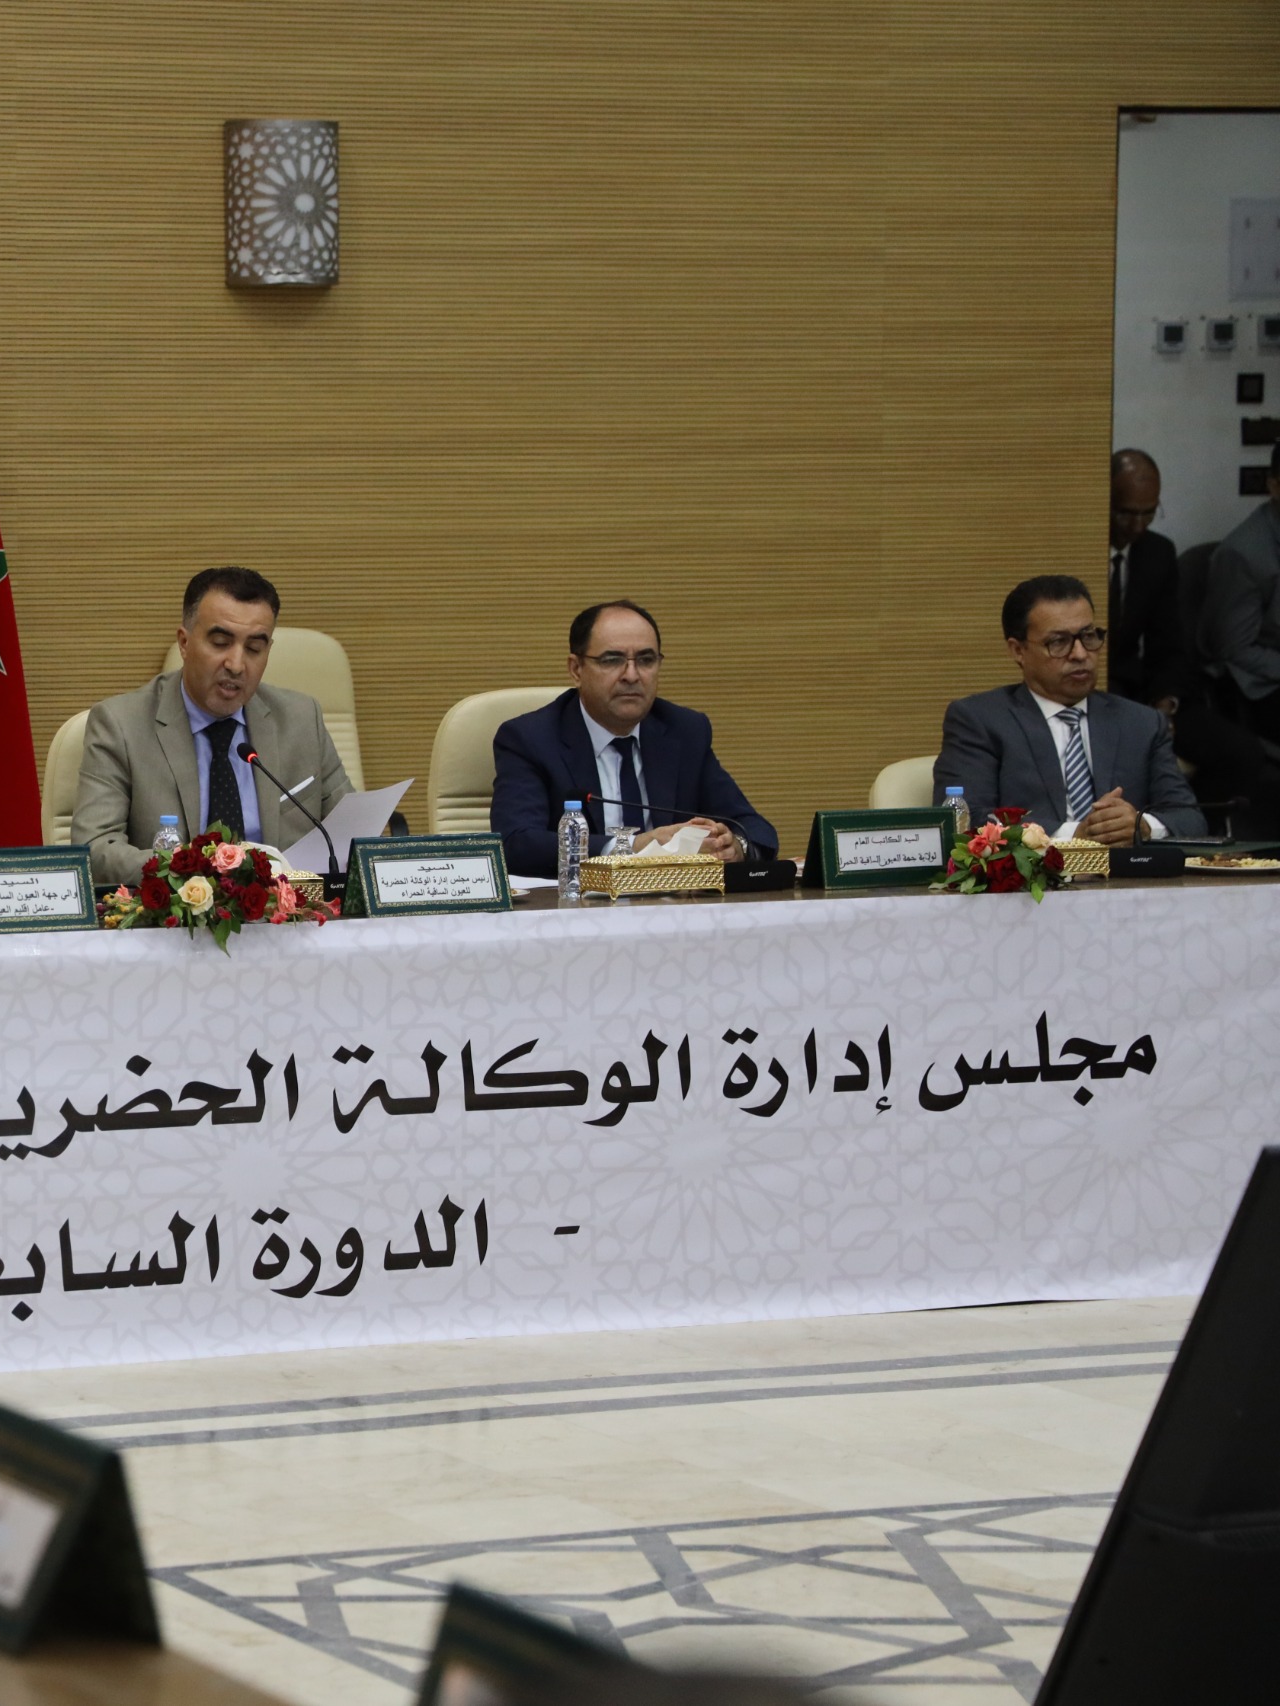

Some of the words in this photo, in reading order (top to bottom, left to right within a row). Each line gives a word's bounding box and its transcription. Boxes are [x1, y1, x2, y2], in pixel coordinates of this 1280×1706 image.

[417, 863, 455, 872] السيد
[0, 878, 39, 888] السيد
[381, 877, 409, 888] الحضرية
[410, 876, 431, 886] الوكالة
[450, 875, 470, 885] مجلس
[17, 890, 40, 902] العيون
[42, 888, 58, 899] جهة
[919, 1011, 1157, 1111] مجلس
[722, 1025, 891, 1117] إدارة
[333, 1030, 691, 1133] الوكالة
[251, 1195, 488, 1298] الدورة
